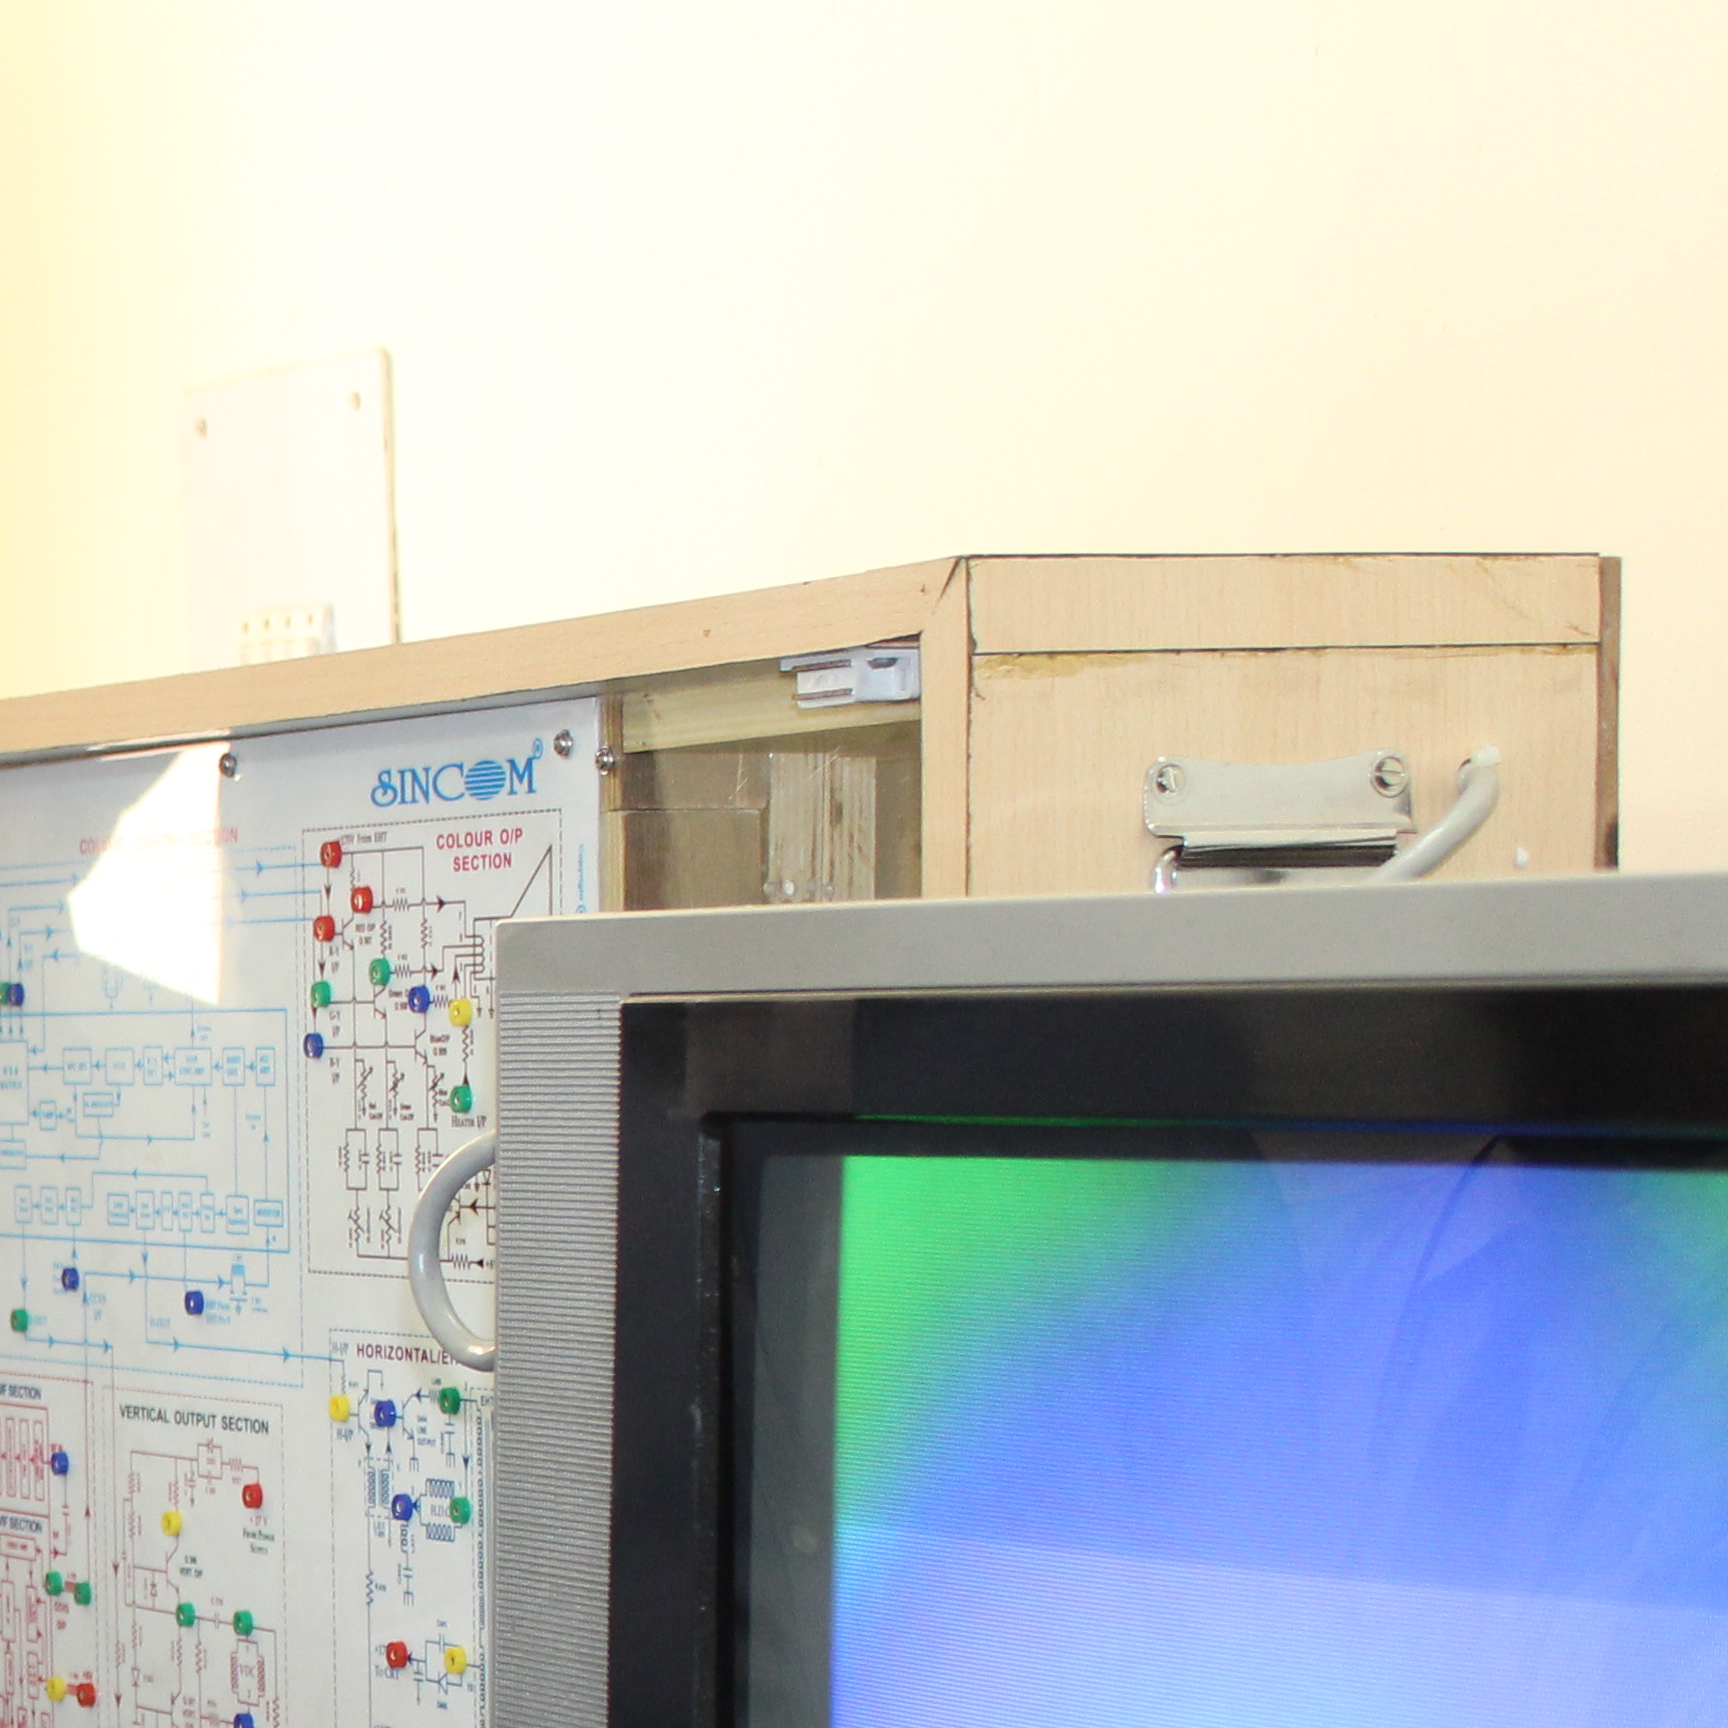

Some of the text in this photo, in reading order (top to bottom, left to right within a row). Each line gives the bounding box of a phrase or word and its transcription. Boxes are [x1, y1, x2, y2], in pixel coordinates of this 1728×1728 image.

[371, 757, 538, 807] SINCOM
[436, 828, 524, 850] COLOUR O/P
[453, 853, 512, 872] SECTION
[119, 1404, 270, 1435] VERTICAL OUTPUT SECTION
